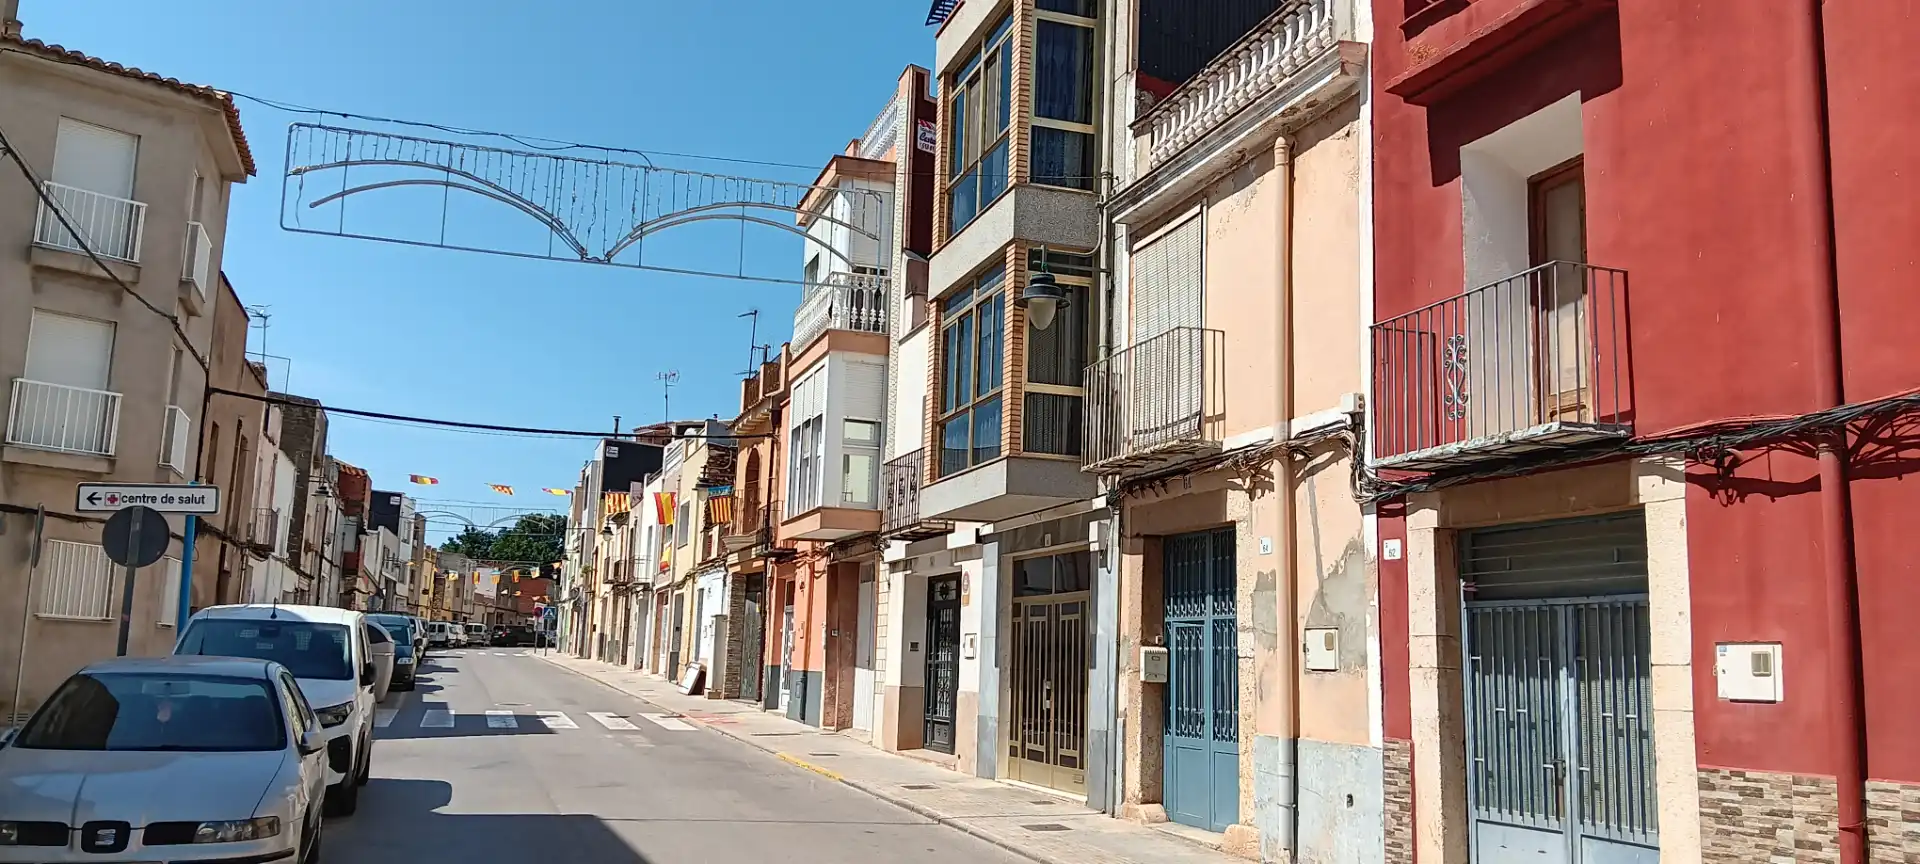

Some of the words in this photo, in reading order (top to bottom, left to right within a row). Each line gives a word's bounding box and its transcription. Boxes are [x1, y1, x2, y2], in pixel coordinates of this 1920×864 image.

[121, 493, 157, 504] centre
[160, 493, 175, 504] de
[178, 494, 205, 505] salut
